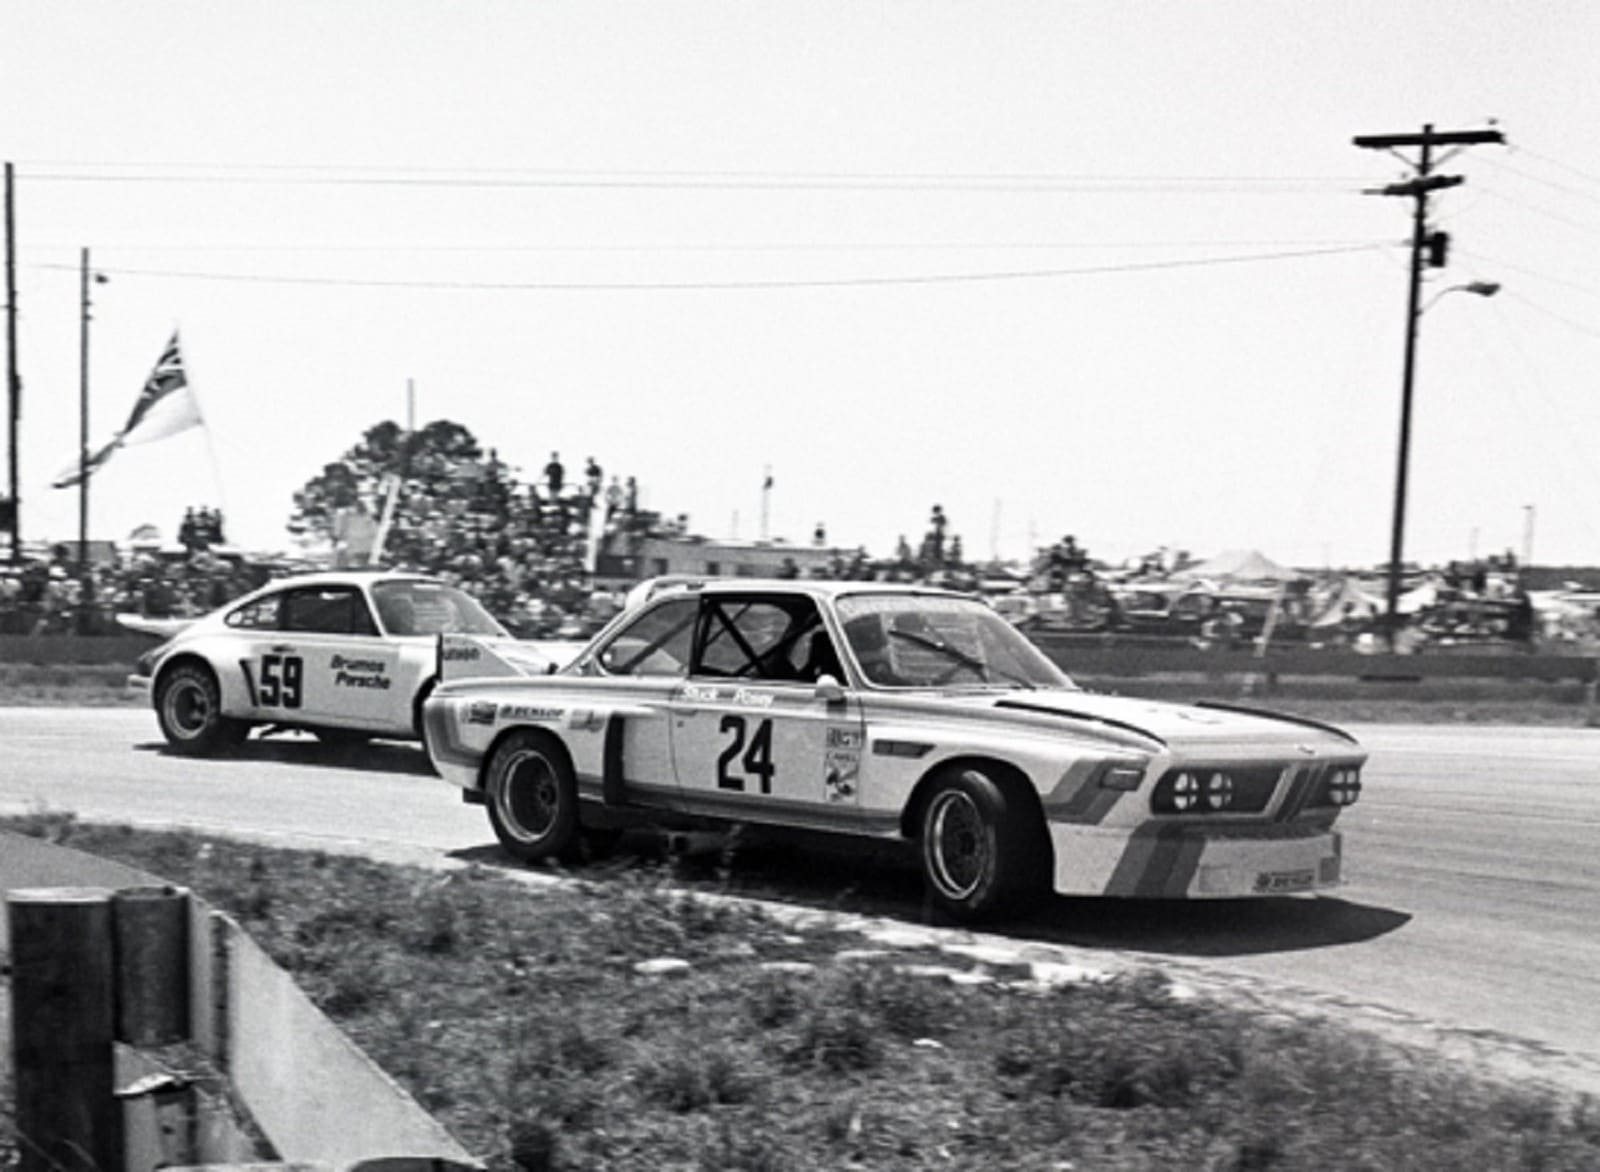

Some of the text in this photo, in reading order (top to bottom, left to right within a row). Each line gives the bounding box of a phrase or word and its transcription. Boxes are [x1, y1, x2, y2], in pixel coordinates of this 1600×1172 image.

[260, 654, 303, 708] 59
[331, 654, 386, 673] Brumos
[335, 671, 391, 690] Porsche
[718, 714, 774, 793] 24
